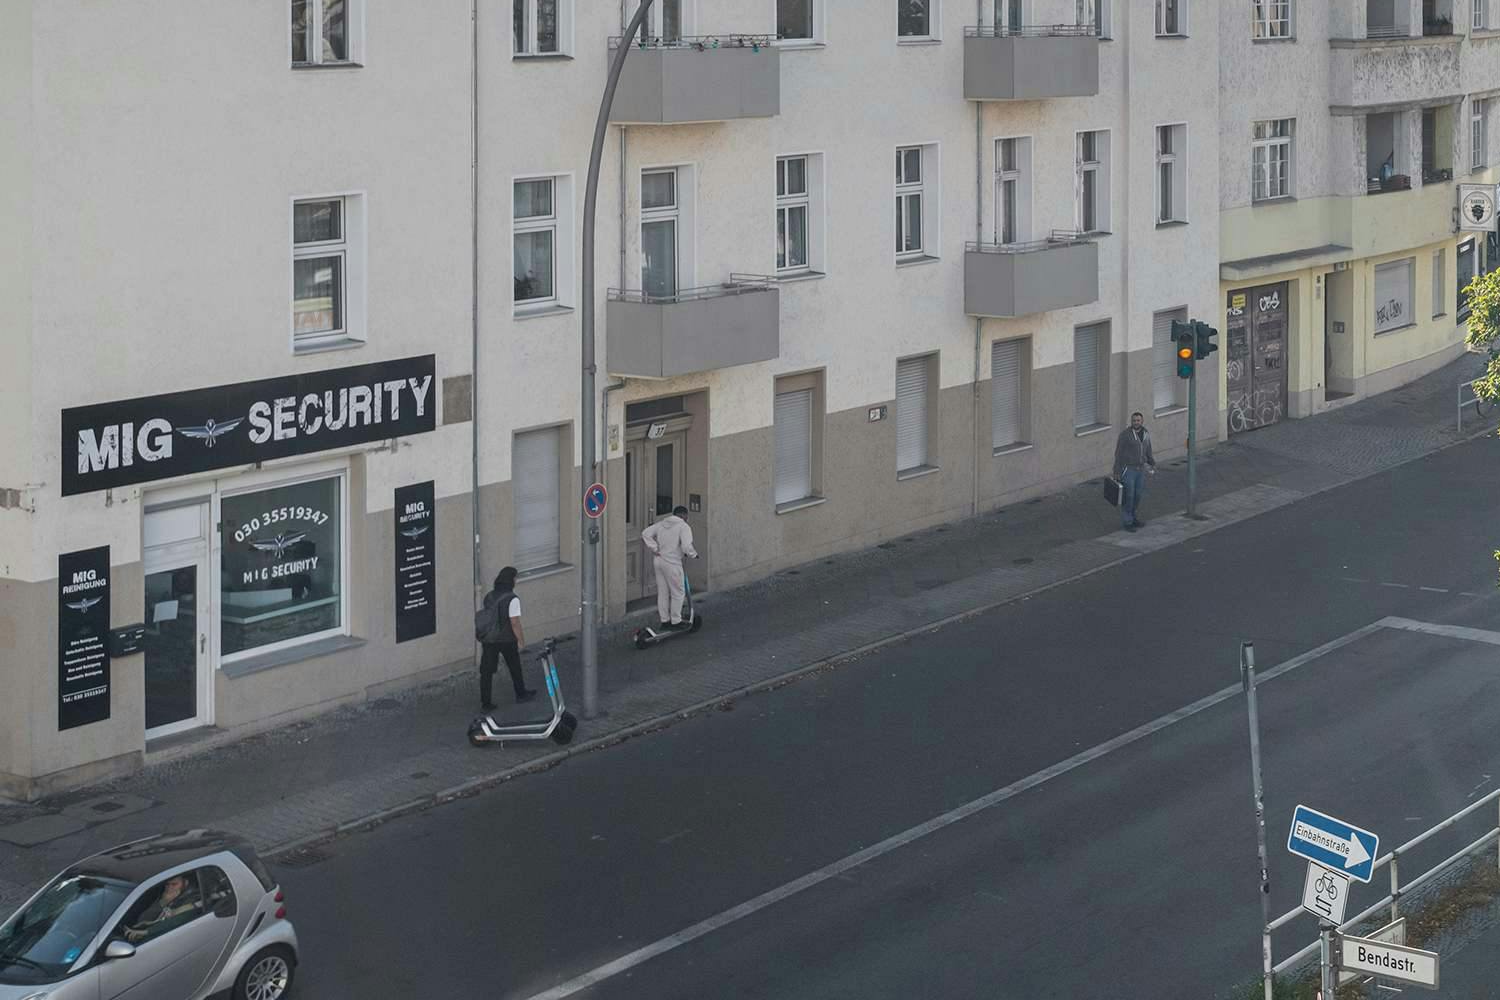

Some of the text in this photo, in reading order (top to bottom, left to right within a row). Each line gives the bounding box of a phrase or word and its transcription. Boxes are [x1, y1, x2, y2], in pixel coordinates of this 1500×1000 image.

[78, 374, 433, 475] MIG SECURITY
[405, 501, 425, 515] MIG
[234, 506, 329, 543] 030 35519347
[72, 569, 97, 585] MIG
[271, 556, 319, 578] SECURITY
[62, 578, 107, 595] REINIGUNG
[1296, 825, 1350, 855] Einbahnstraße
[1358, 946, 1416, 973] Bendastr.
